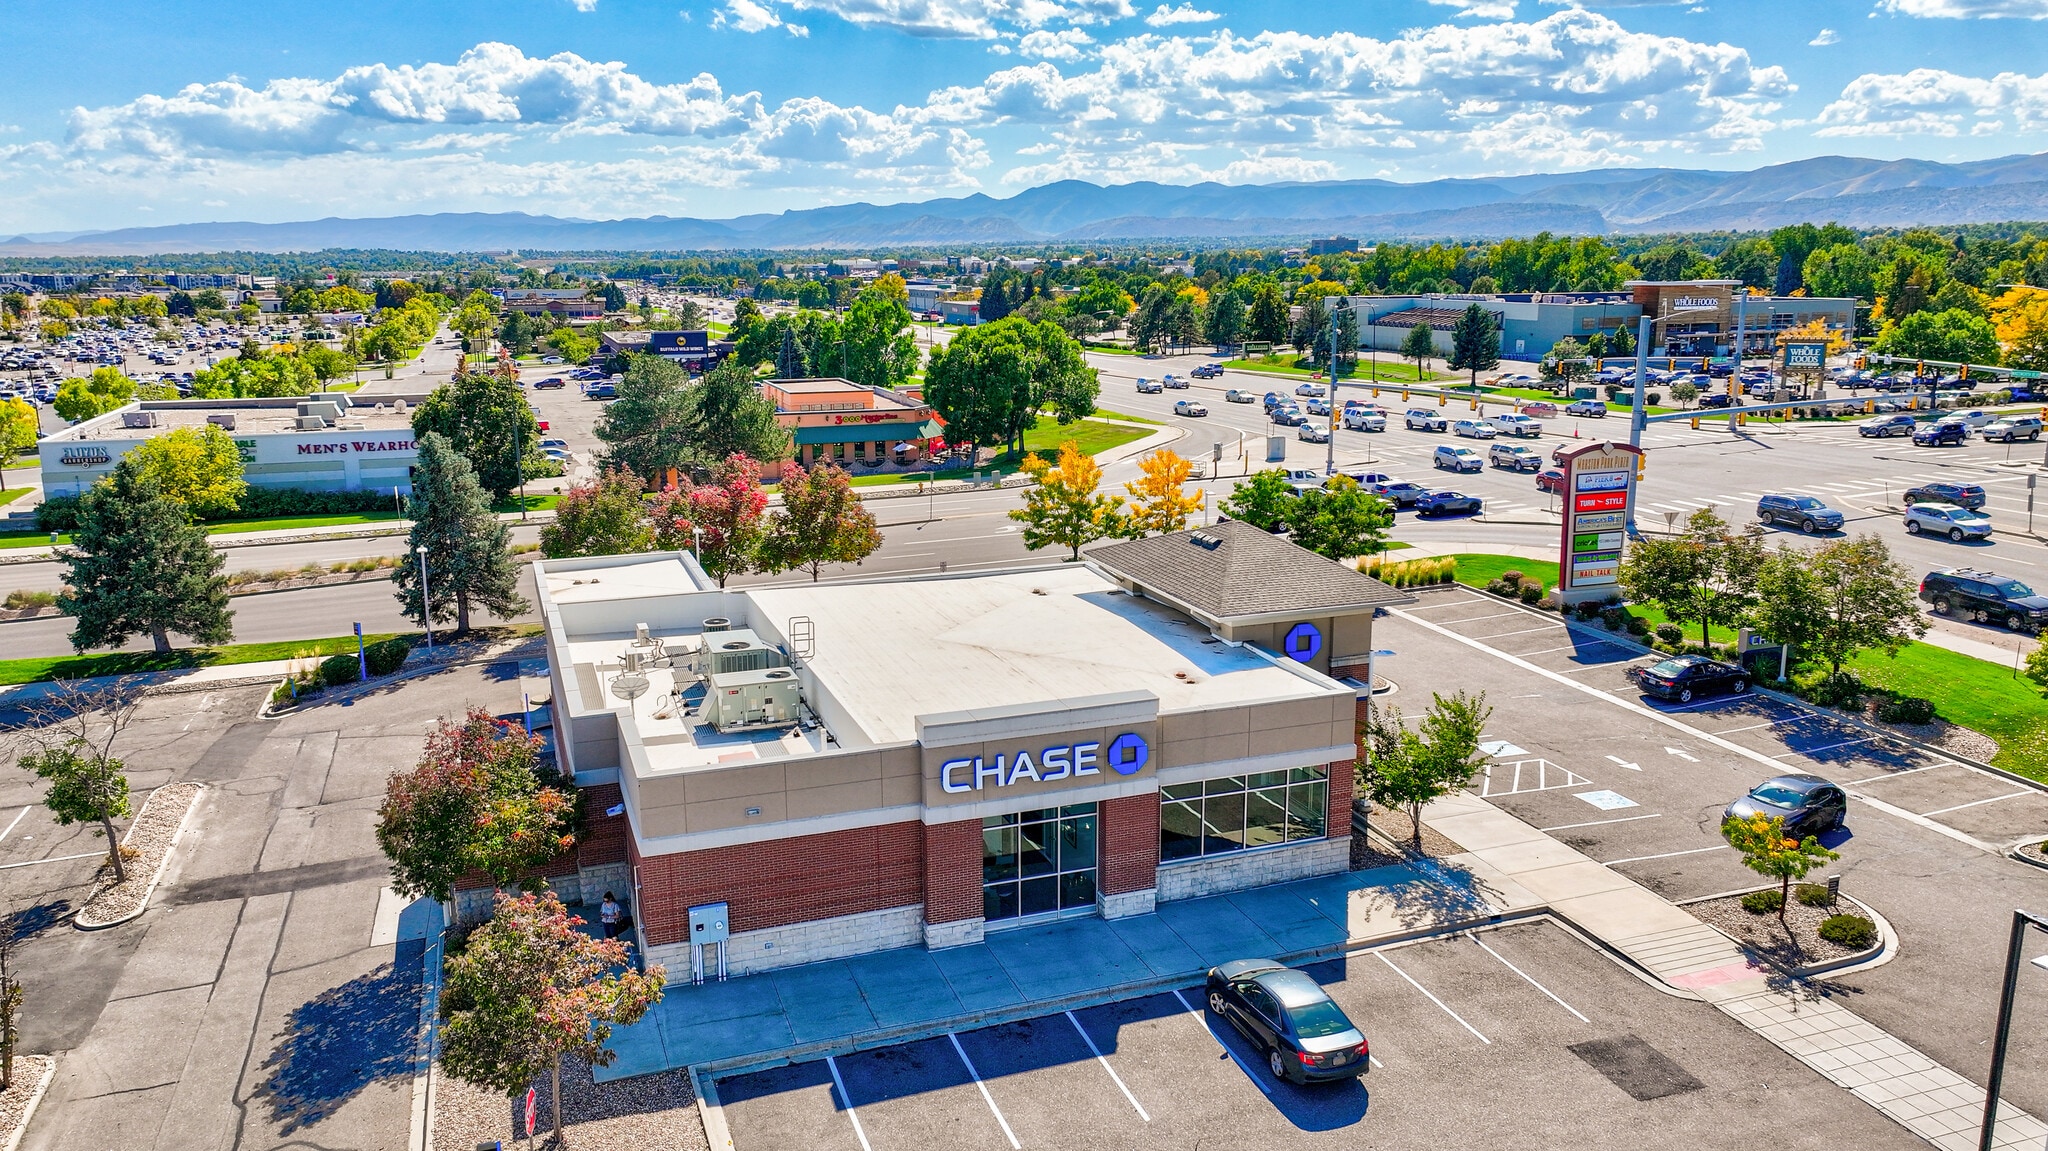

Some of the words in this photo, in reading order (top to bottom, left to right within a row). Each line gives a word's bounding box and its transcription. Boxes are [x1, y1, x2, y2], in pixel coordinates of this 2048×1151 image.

[1673, 298, 1697, 306] WHOLE
[1698, 297, 1719, 306] FOODS
[1790, 348, 1821, 356] WHOLE
[1791, 355, 1819, 363] FOODS
[297, 443, 348, 455] MEN'S
[1605, 497, 1624, 506] STYLE
[941, 742, 1101, 794] CHASE
